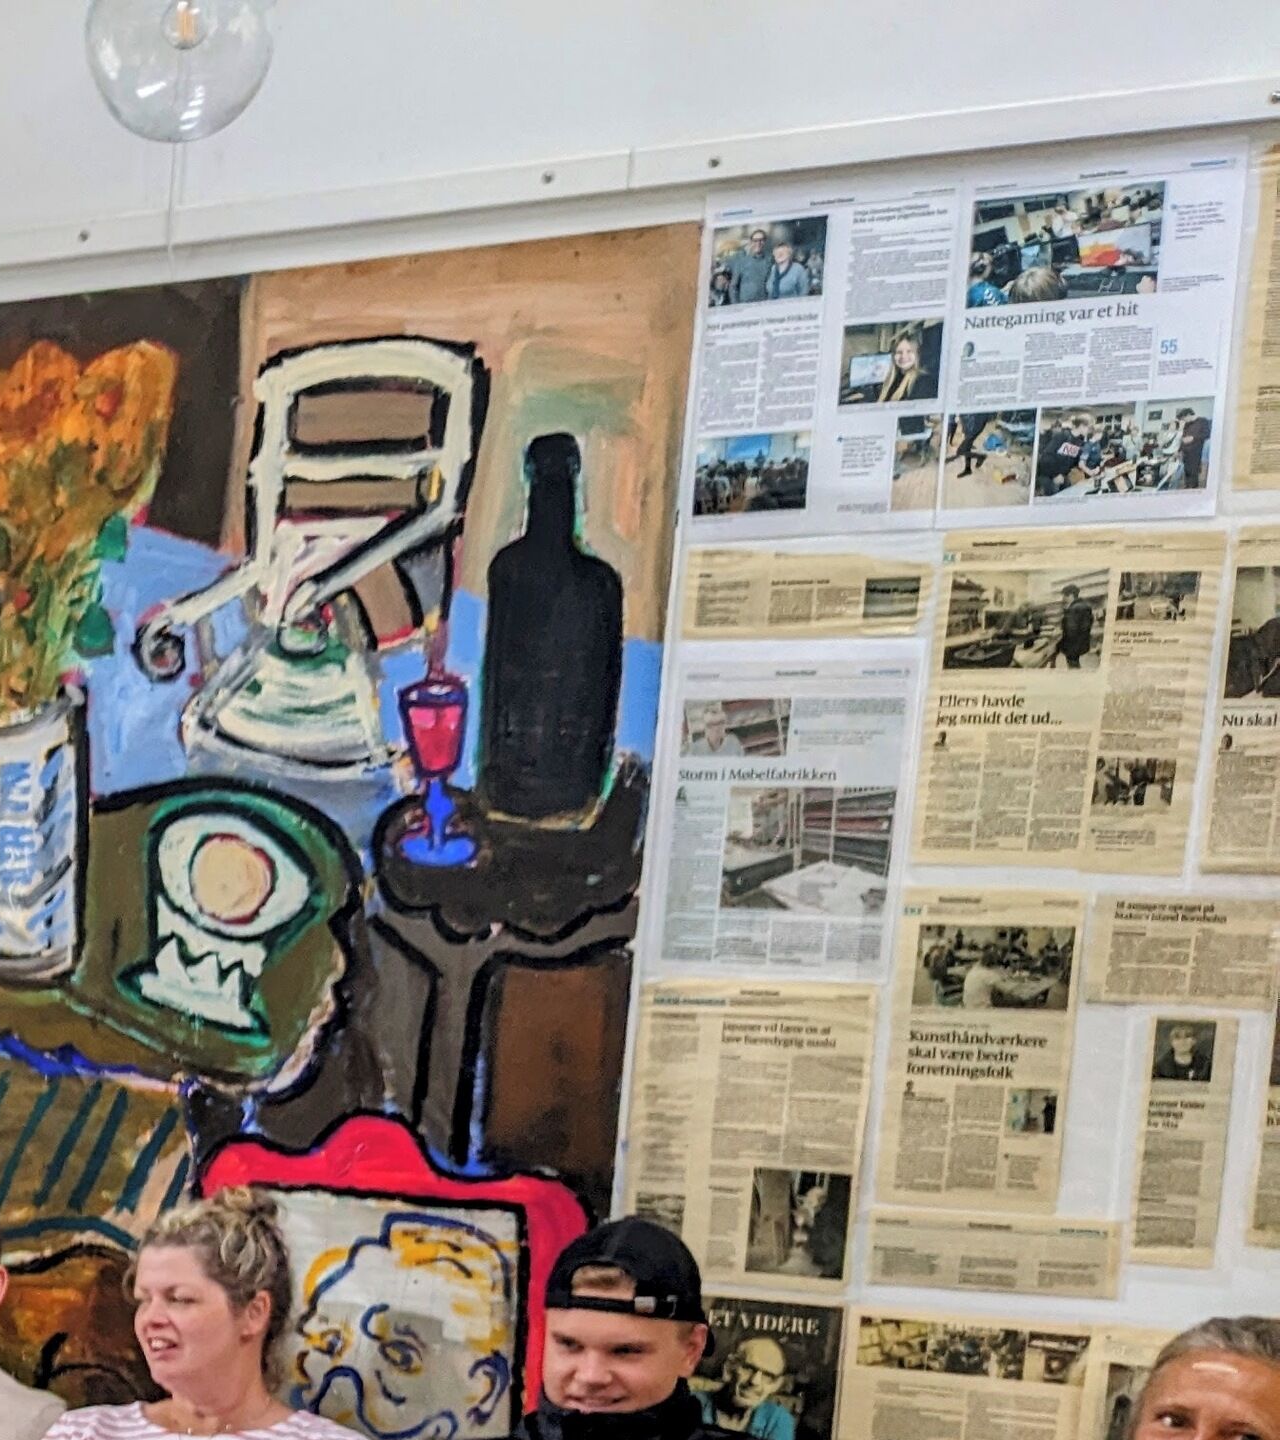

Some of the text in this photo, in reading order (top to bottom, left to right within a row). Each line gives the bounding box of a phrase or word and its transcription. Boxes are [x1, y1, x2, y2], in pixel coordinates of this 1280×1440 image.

[963, 302, 1140, 333] Nattegaming var et hit
[1160, 338, 1179, 355] 55
[938, 693, 1025, 709] Ellers havde
[935, 711, 1063, 728] jeg smidt det ud...
[1222, 712, 1278, 728] Nu skal
[678, 768, 720, 782] Storm
[728, 767, 837, 782] Møbelfabrikken
[908, 1030, 1048, 1049] Kunsthåndværkere
[908, 1047, 1019, 1063] skal være bedre
[906, 1062, 1014, 1080] forretningsfolk
[738, 1313, 820, 1335] VIDERE
